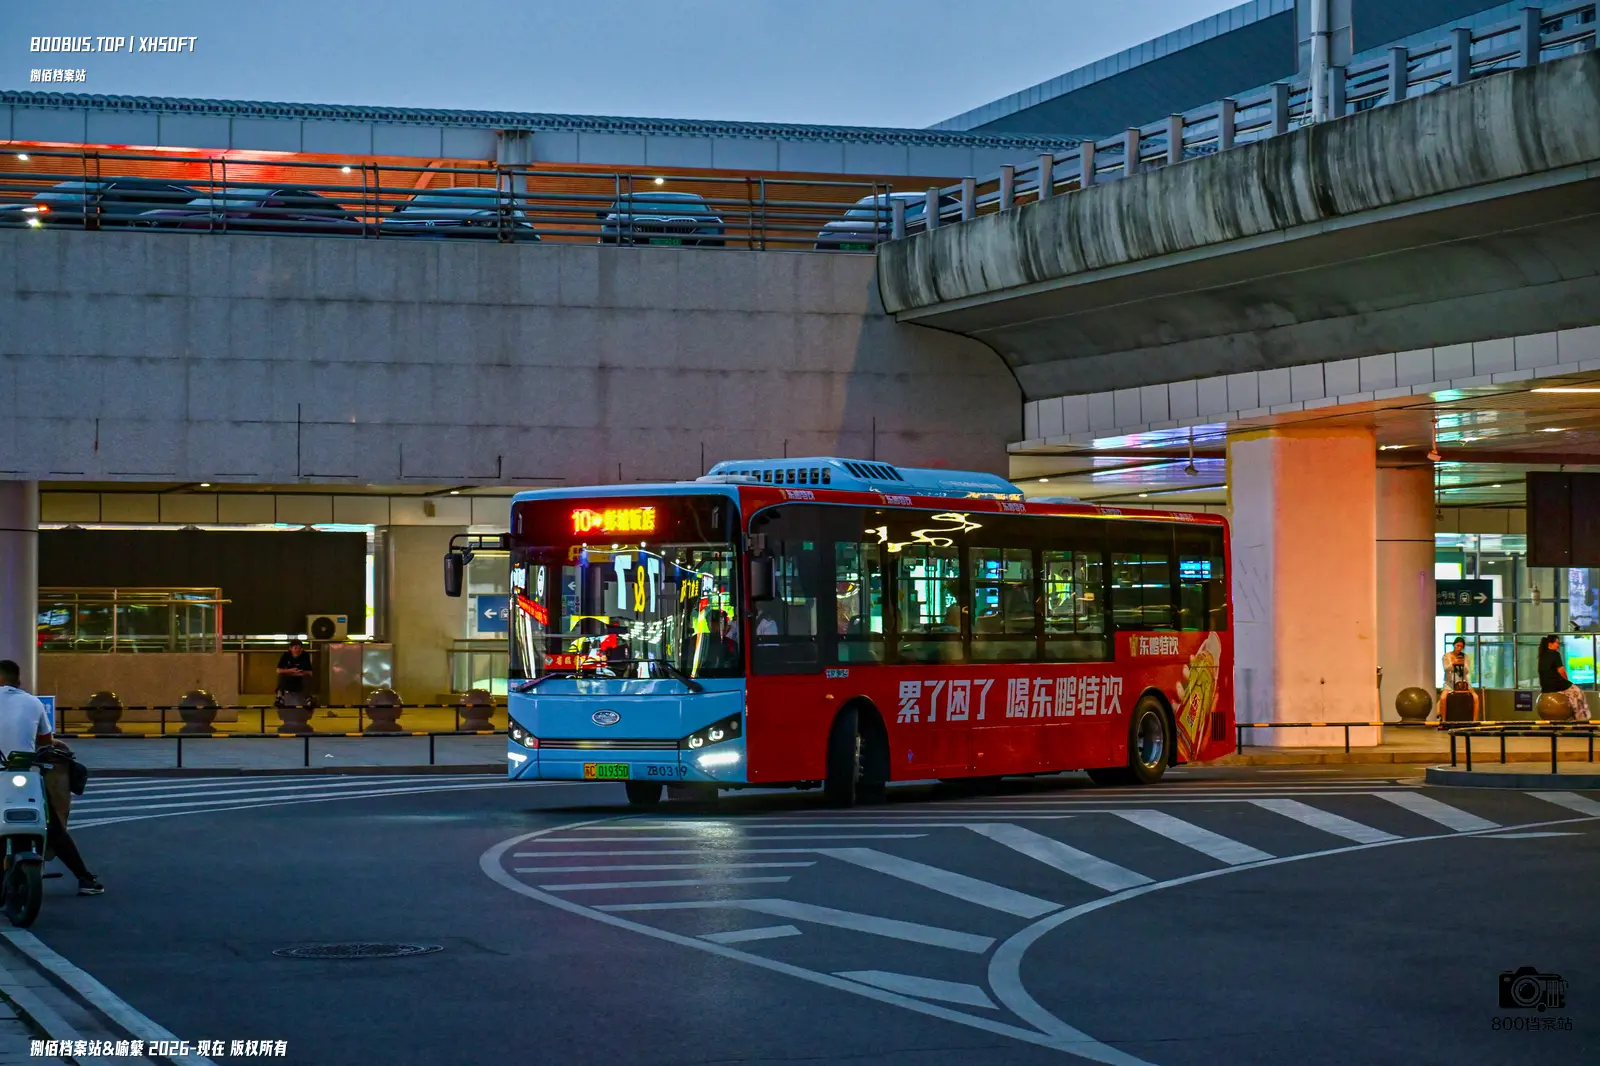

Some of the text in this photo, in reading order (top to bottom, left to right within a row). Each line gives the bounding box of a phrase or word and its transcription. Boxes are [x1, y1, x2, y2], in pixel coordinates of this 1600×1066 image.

[571, 510, 591, 532] 10
[1139, 635, 1179, 655] 东鹏特饮
[897, 675, 1123, 723] 累了困了 喝东鹏特饮
[646, 765, 688, 777] ZB0319
